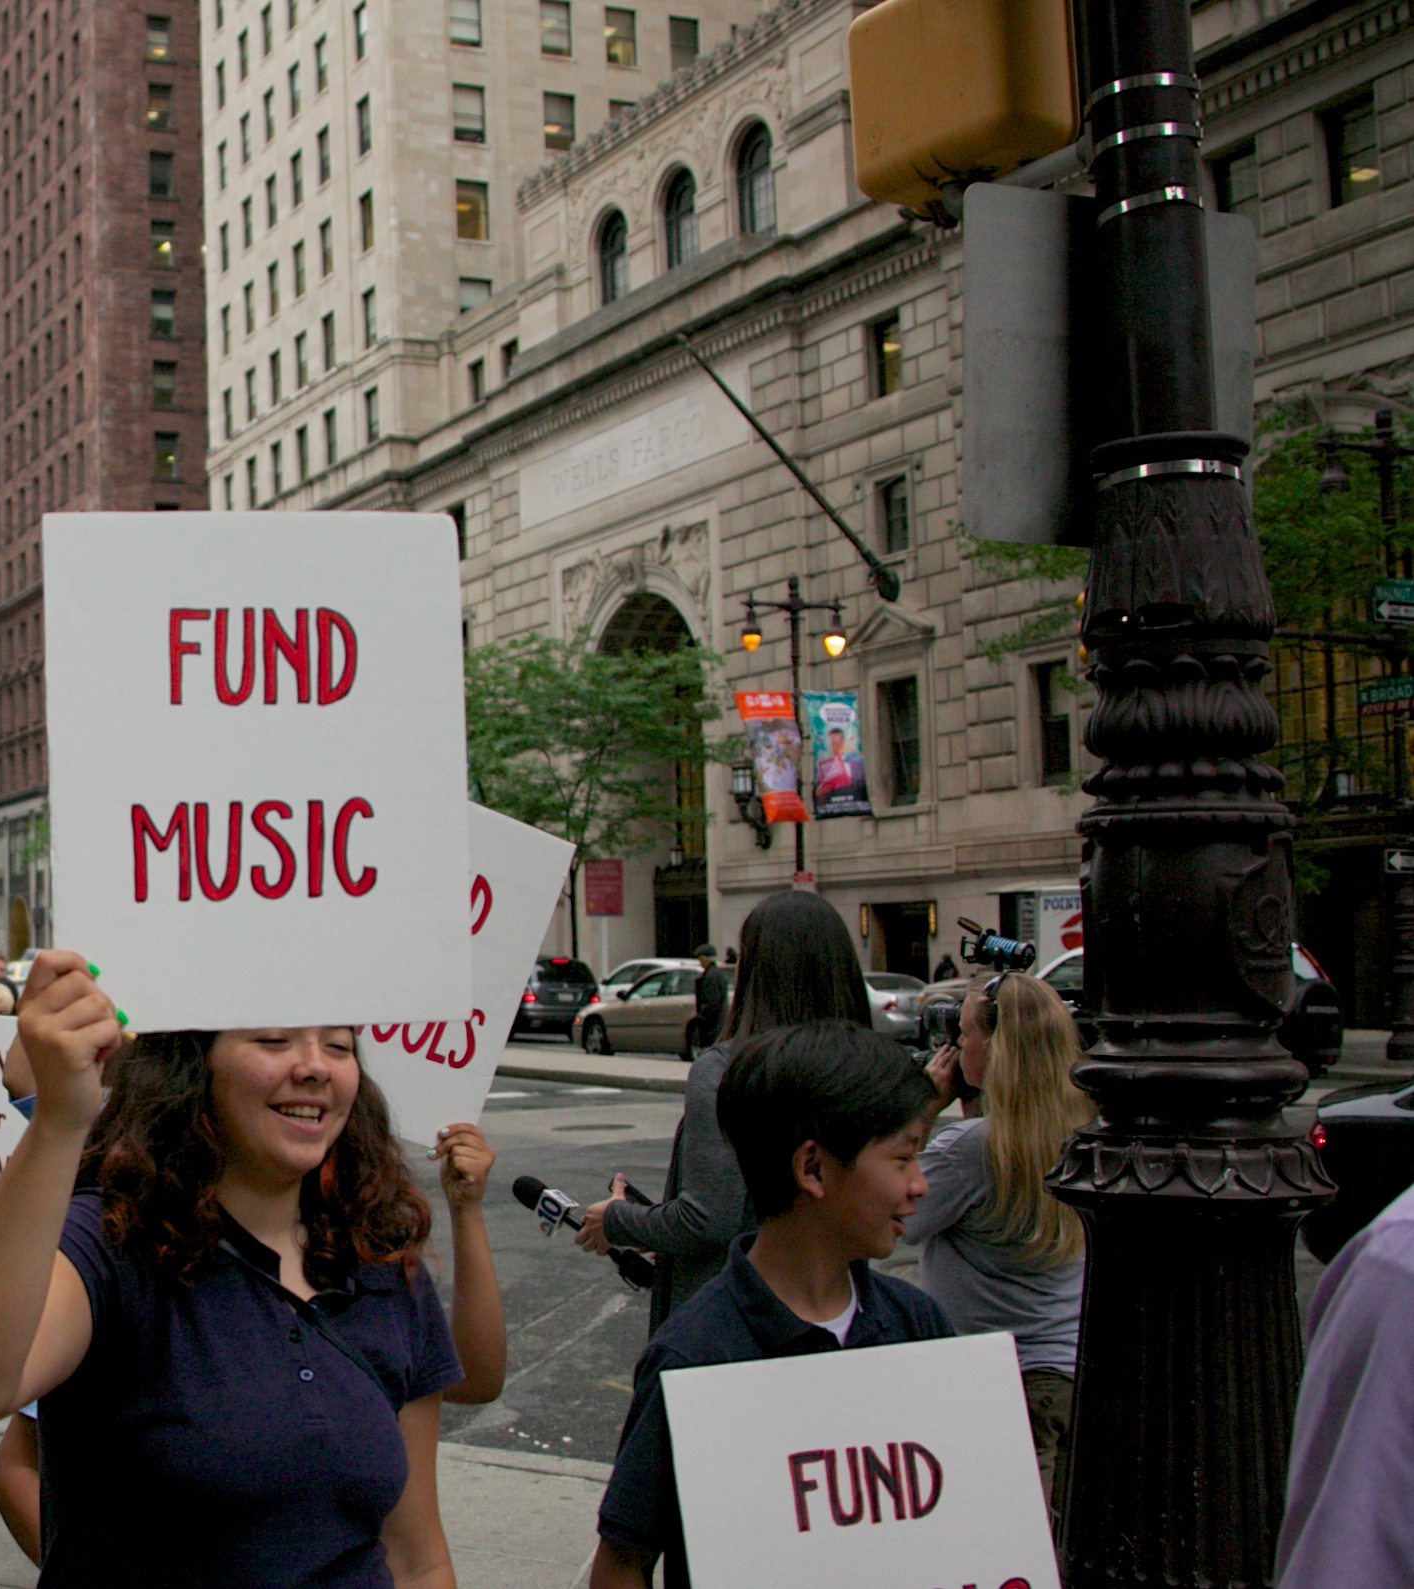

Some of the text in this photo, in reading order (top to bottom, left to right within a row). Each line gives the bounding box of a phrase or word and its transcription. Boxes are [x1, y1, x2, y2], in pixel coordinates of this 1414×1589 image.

[551, 410, 705, 495] WELLS FARGO
[169, 606, 358, 706] FUND
[1371, 683, 1414, 703] BROAD
[131, 796, 378, 903] MUSIC
[537, 1195, 563, 1226] 10
[787, 1441, 944, 1532] FUND
